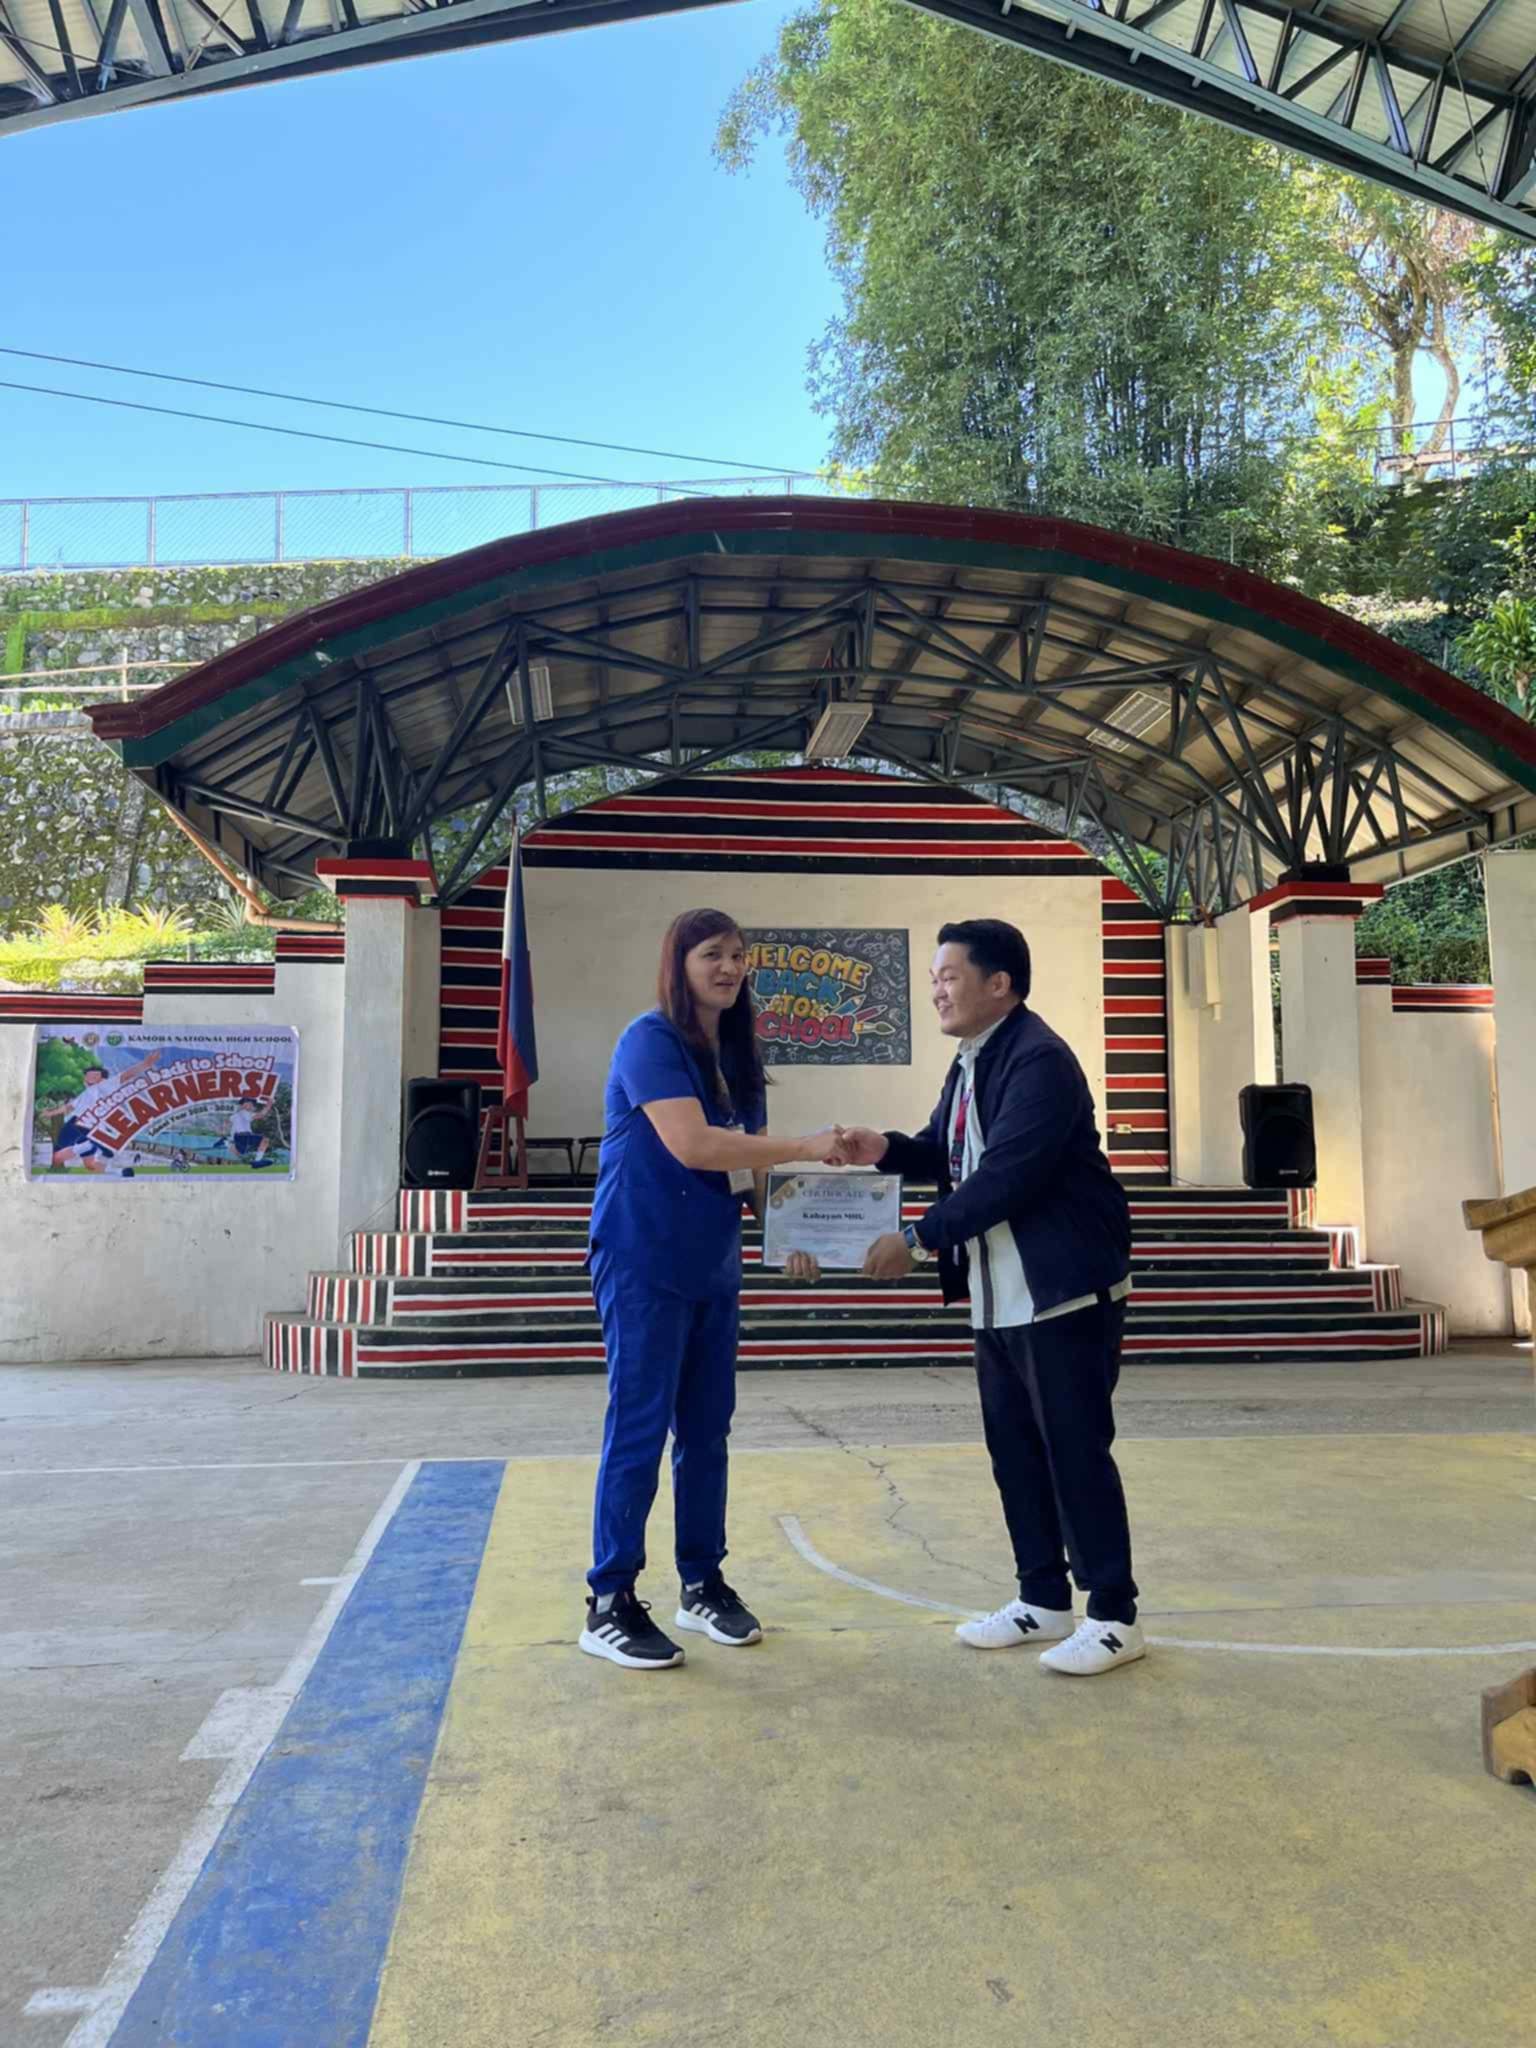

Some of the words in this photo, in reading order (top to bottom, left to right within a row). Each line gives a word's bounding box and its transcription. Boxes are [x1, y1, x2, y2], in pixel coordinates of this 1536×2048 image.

[756, 969, 842, 1005] BACK
[782, 995, 811, 1017] TO
[755, 1011, 854, 1044] CHOOL
[175, 1035, 223, 1043] NATIONAL
[76, 1077, 148, 1129] Welcome
[146, 1059, 188, 1084] back
[190, 1055, 210, 1071] to
[214, 1053, 275, 1072] School
[90, 1070, 278, 1151] LEARNERS!
[802, 1212, 842, 1221] Kabayan
[1013, 1613, 1040, 1635] N
[1099, 1632, 1124, 1654] N
